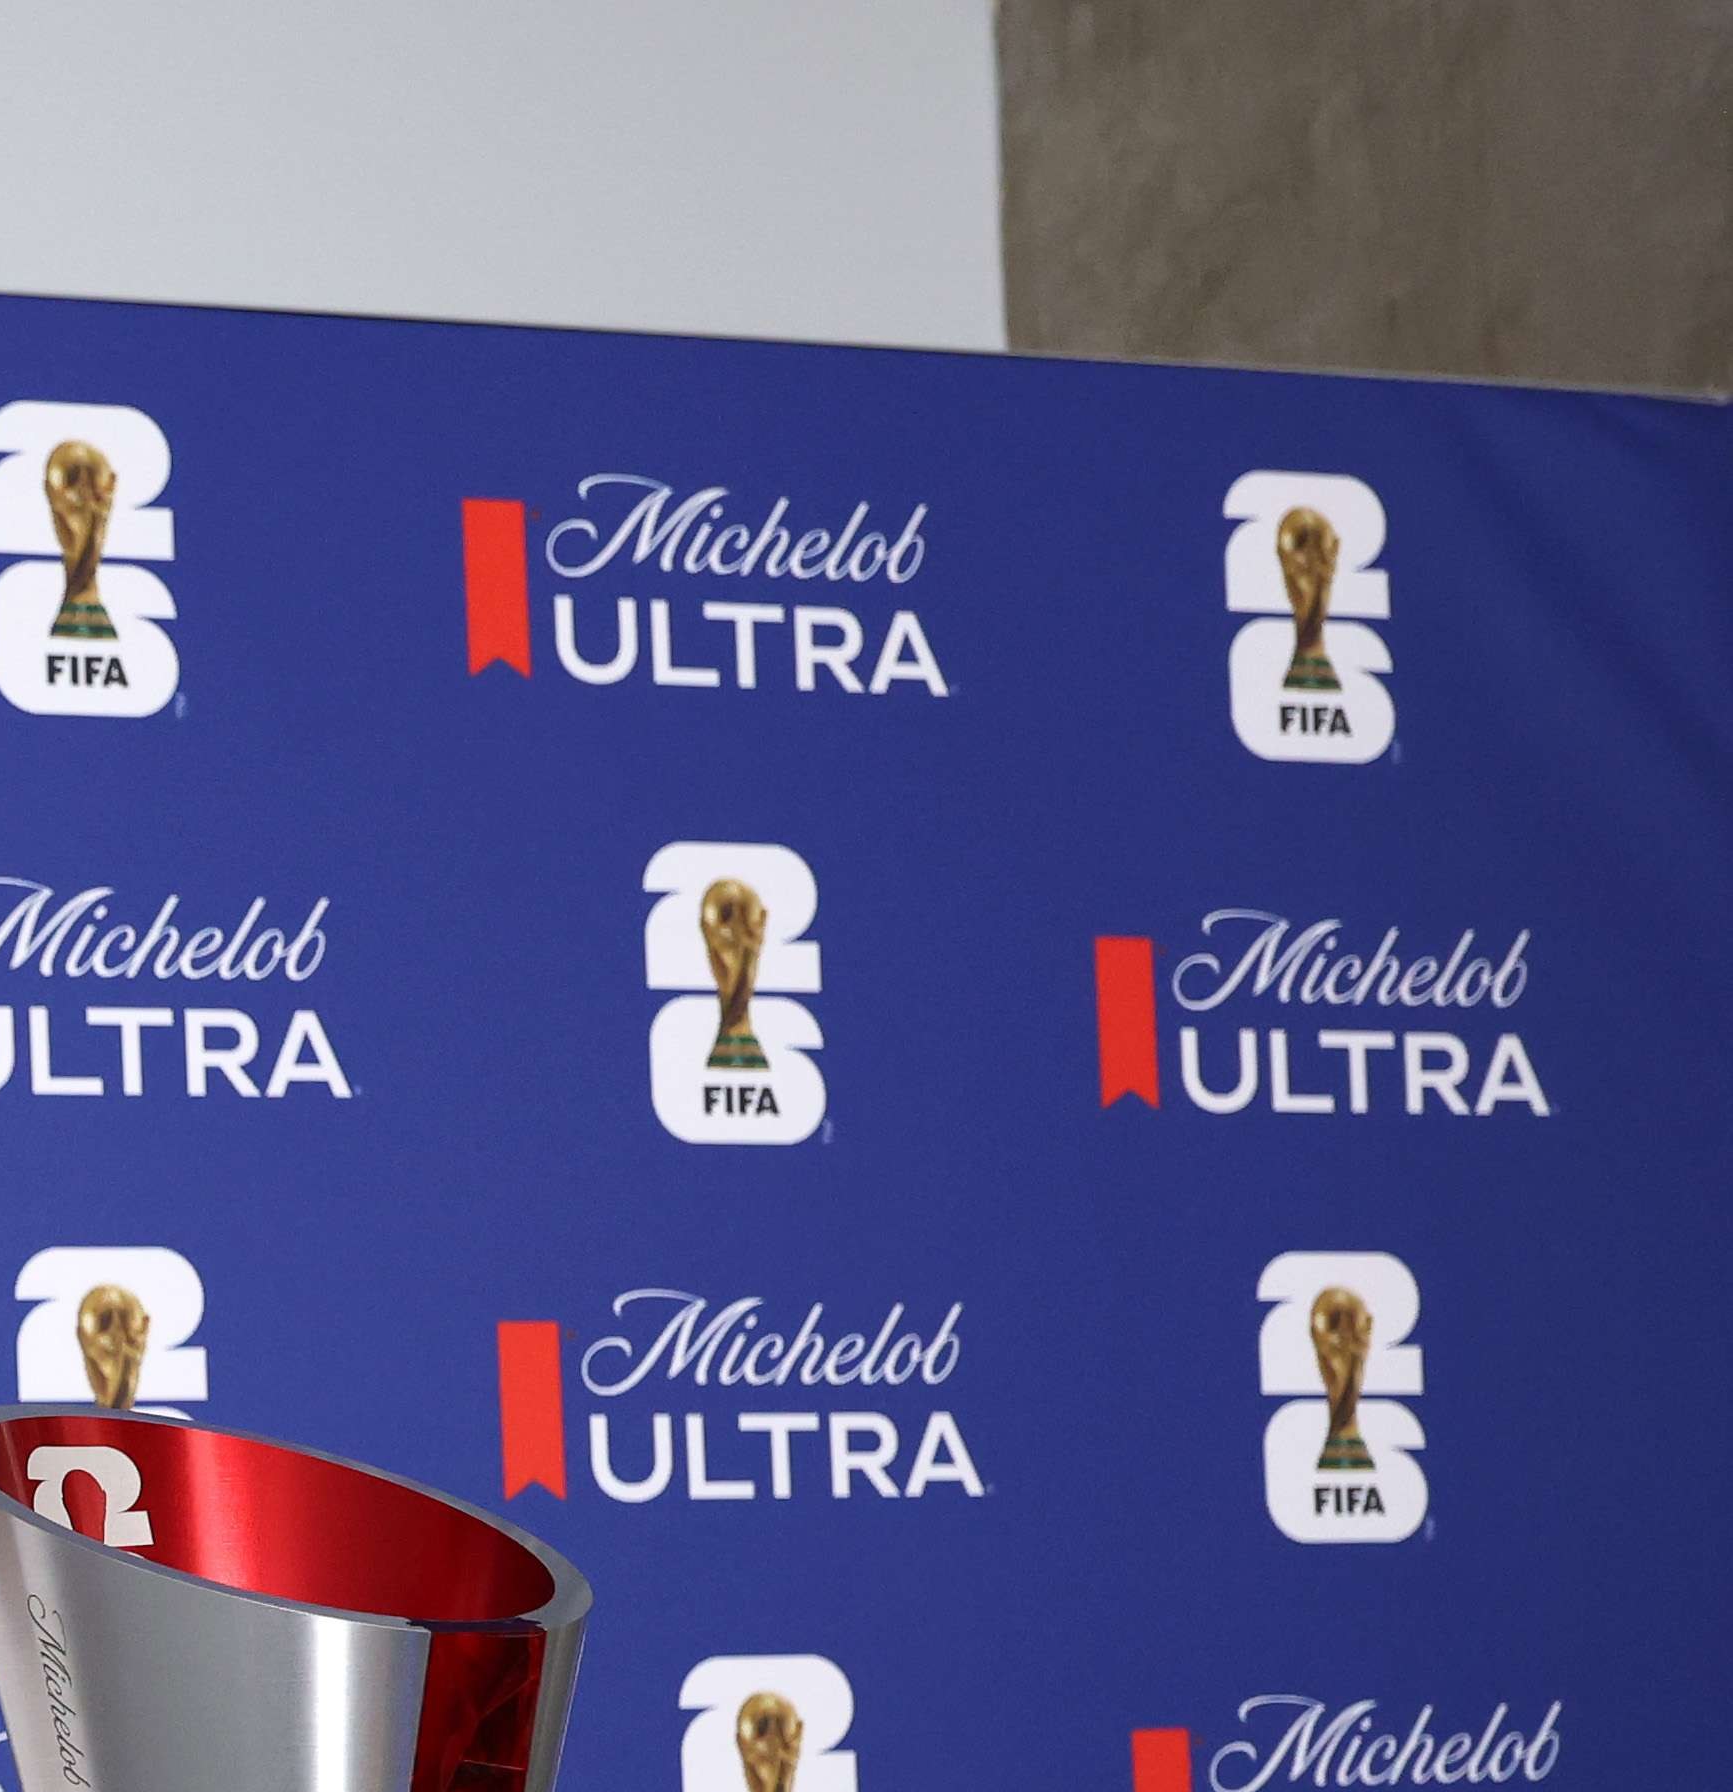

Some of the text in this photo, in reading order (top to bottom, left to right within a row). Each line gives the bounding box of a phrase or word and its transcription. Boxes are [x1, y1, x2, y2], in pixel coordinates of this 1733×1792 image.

[545, 473, 927, 584] Michelob
[45, 653, 130, 688] FIFA
[553, 593, 949, 697] ULTRA
[1278, 704, 1352, 736] FIFA
[1172, 908, 1530, 1011] Michelob
[702, 1085, 781, 1116] FIFA
[1179, 1027, 1550, 1117] ULTRA
[581, 1288, 962, 1396] Michelob
[589, 1411, 984, 1503] ULTRA
[1313, 1485, 1386, 1516] FIFA
[26, 1593, 91, 1788] Michelob
